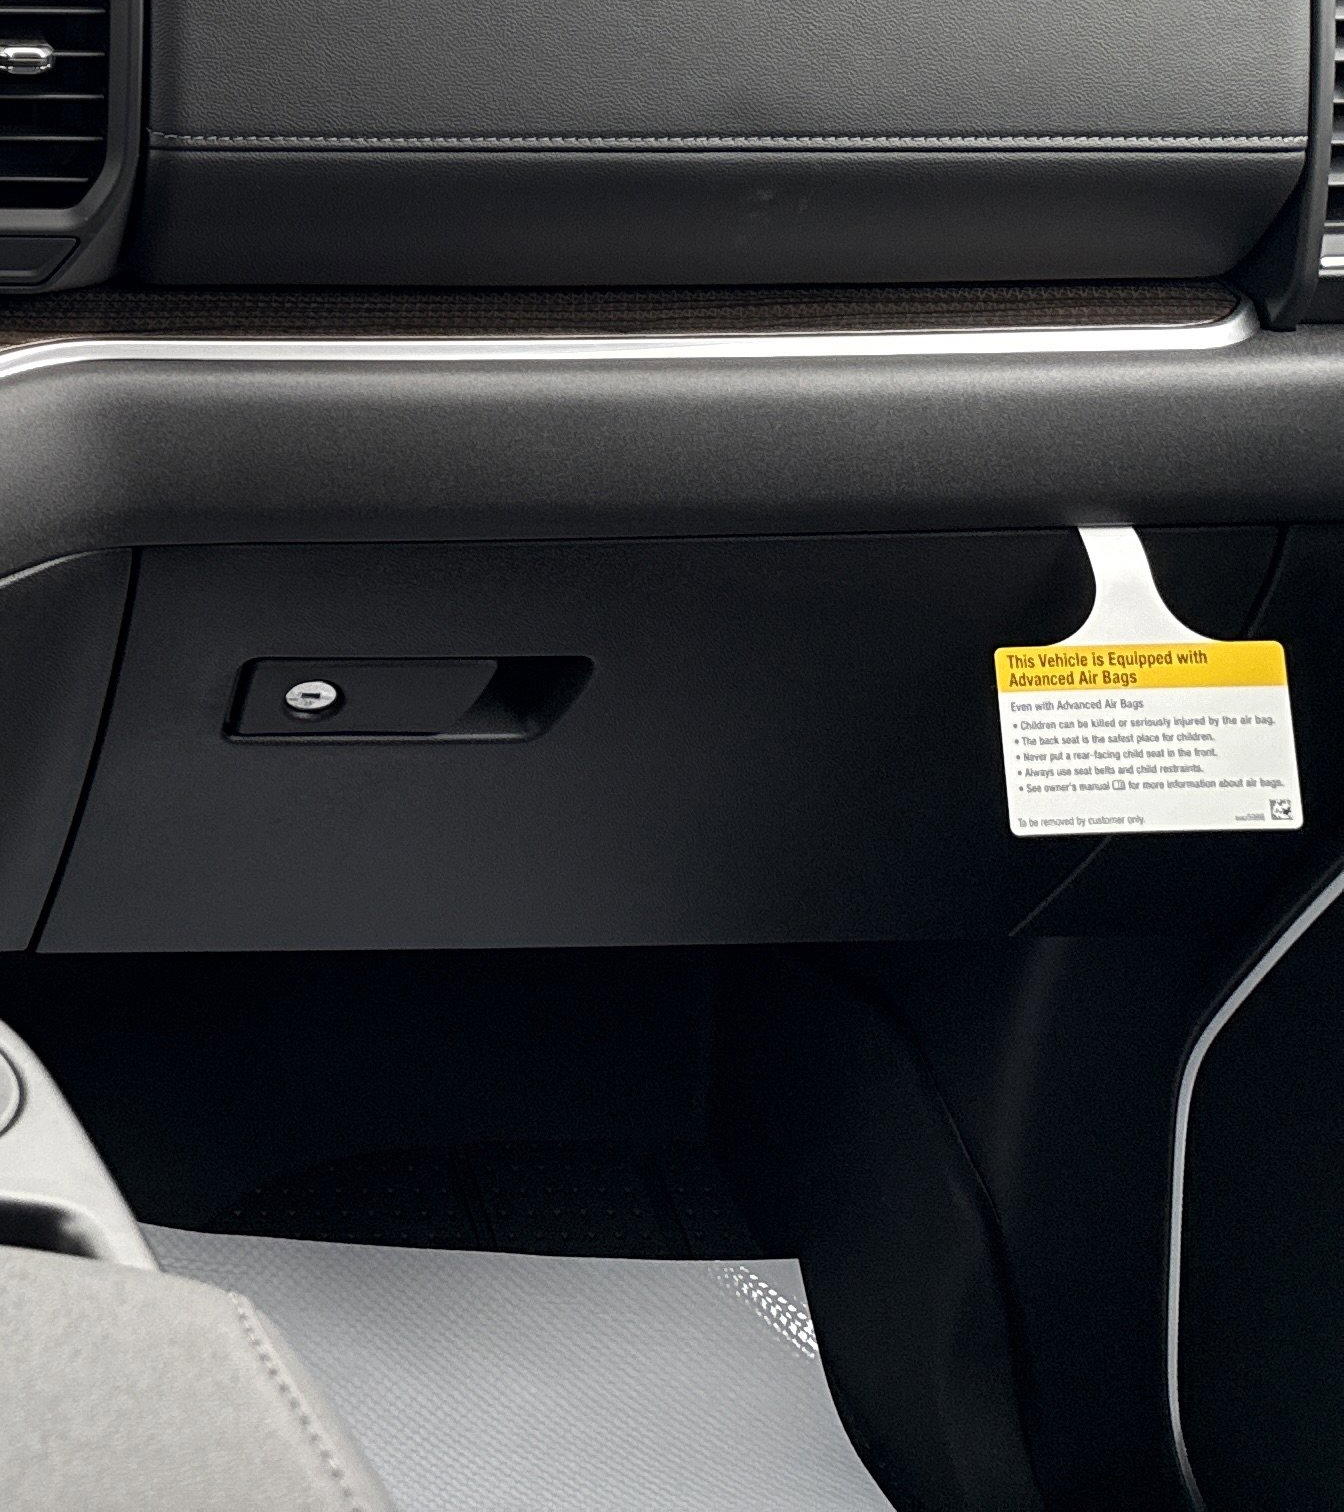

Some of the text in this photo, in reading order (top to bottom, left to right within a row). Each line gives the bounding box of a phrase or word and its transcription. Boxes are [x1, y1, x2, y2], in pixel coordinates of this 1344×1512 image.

[1007, 650, 1207, 669] This Vehicle is Equipped with
[1010, 670, 1137, 687] Advanced Air Bags
[1011, 699, 1144, 712] Even with Advanced Air Bags
[1021, 721, 1056, 730] Children
[1059, 721, 1074, 729] can
[1077, 720, 1088, 728] be
[1091, 718, 1115, 727] killed
[1131, 718, 1170, 728] seriously
[1174, 716, 1205, 728] injured
[1208, 716, 1219, 727] by
[1222, 716, 1237, 725] the
[1240, 715, 1252, 724] air
[1255, 715, 1275, 726] bag.
[1022, 732, 1215, 745] The back seat is the safest place for children.
[1024, 753, 1046, 761] Never
[1050, 752, 1063, 763] put
[1073, 750, 1120, 760] rear-facing
[1123, 749, 1144, 758] child
[1146, 749, 1164, 758] seat
[1167, 749, 1175, 757] in
[1178, 748, 1191, 757] the
[1194, 748, 1218, 757] front.
[1025, 768, 1054, 778] Always
[1074, 766, 1092, 775] seat
[1094, 766, 1115, 775] belts
[1118, 765, 1134, 774] and
[1136, 765, 1157, 774] child
